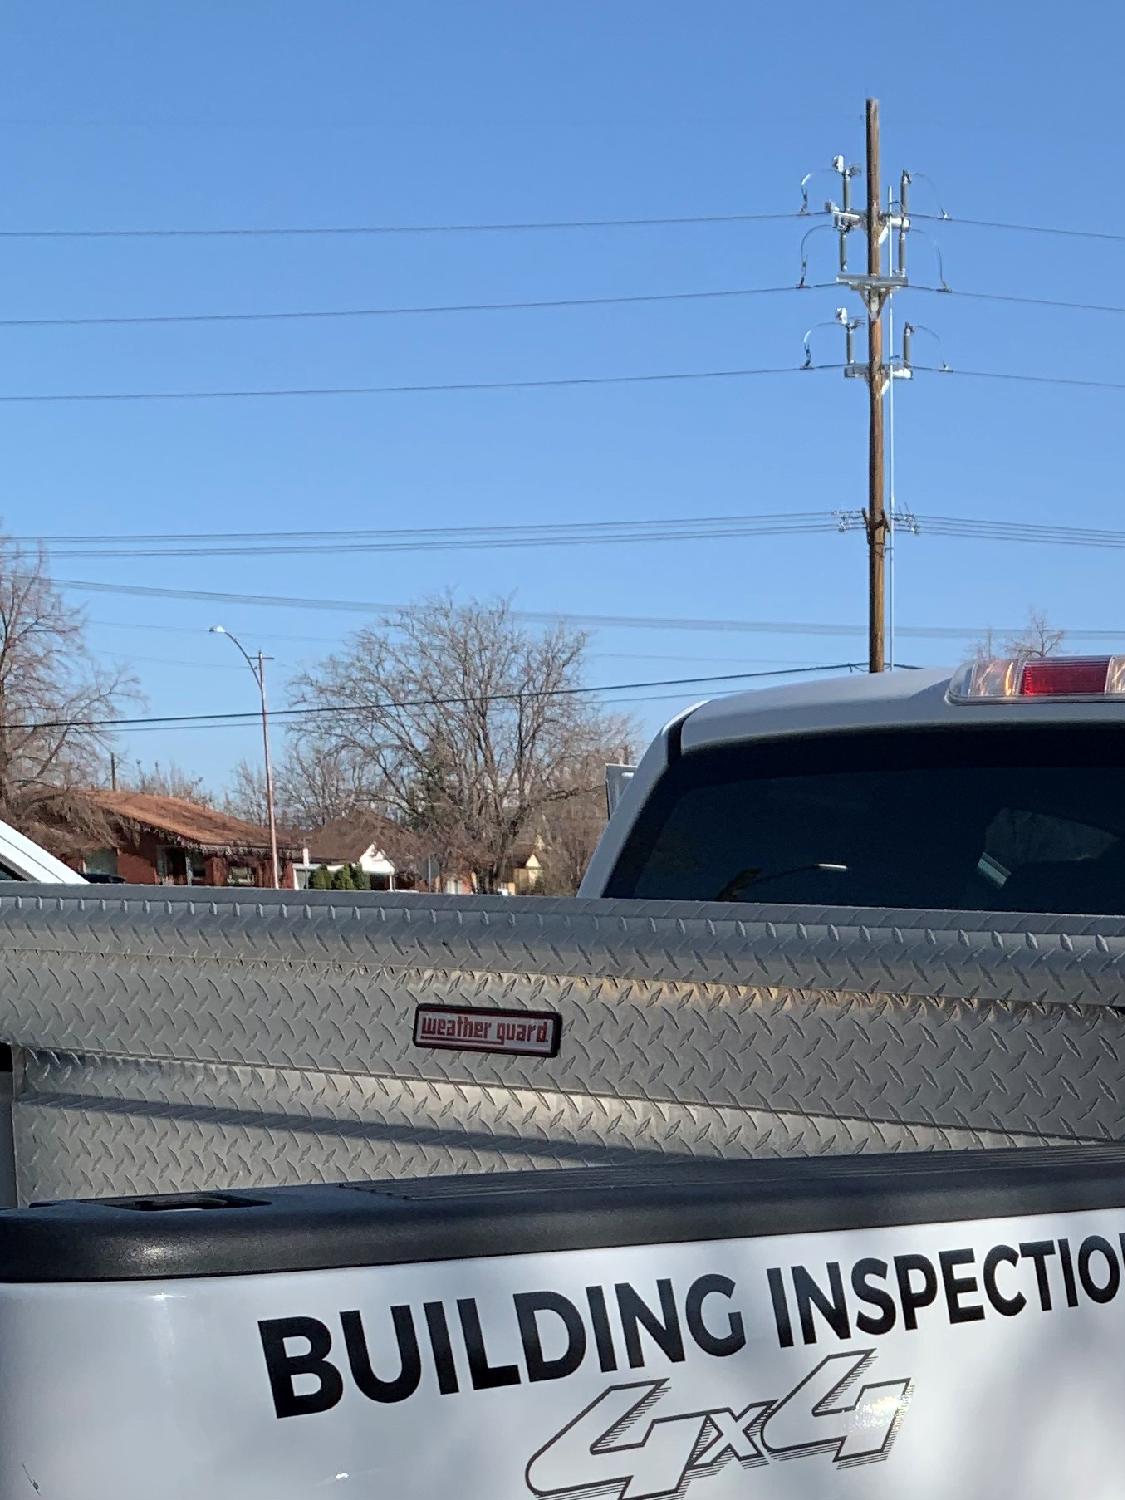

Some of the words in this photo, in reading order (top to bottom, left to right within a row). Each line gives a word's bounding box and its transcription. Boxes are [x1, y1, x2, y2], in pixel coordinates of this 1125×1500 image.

[421, 1015, 492, 1039] weather
[497, 1020, 549, 1046] guard
[258, 1272, 746, 1419] BUILDING
